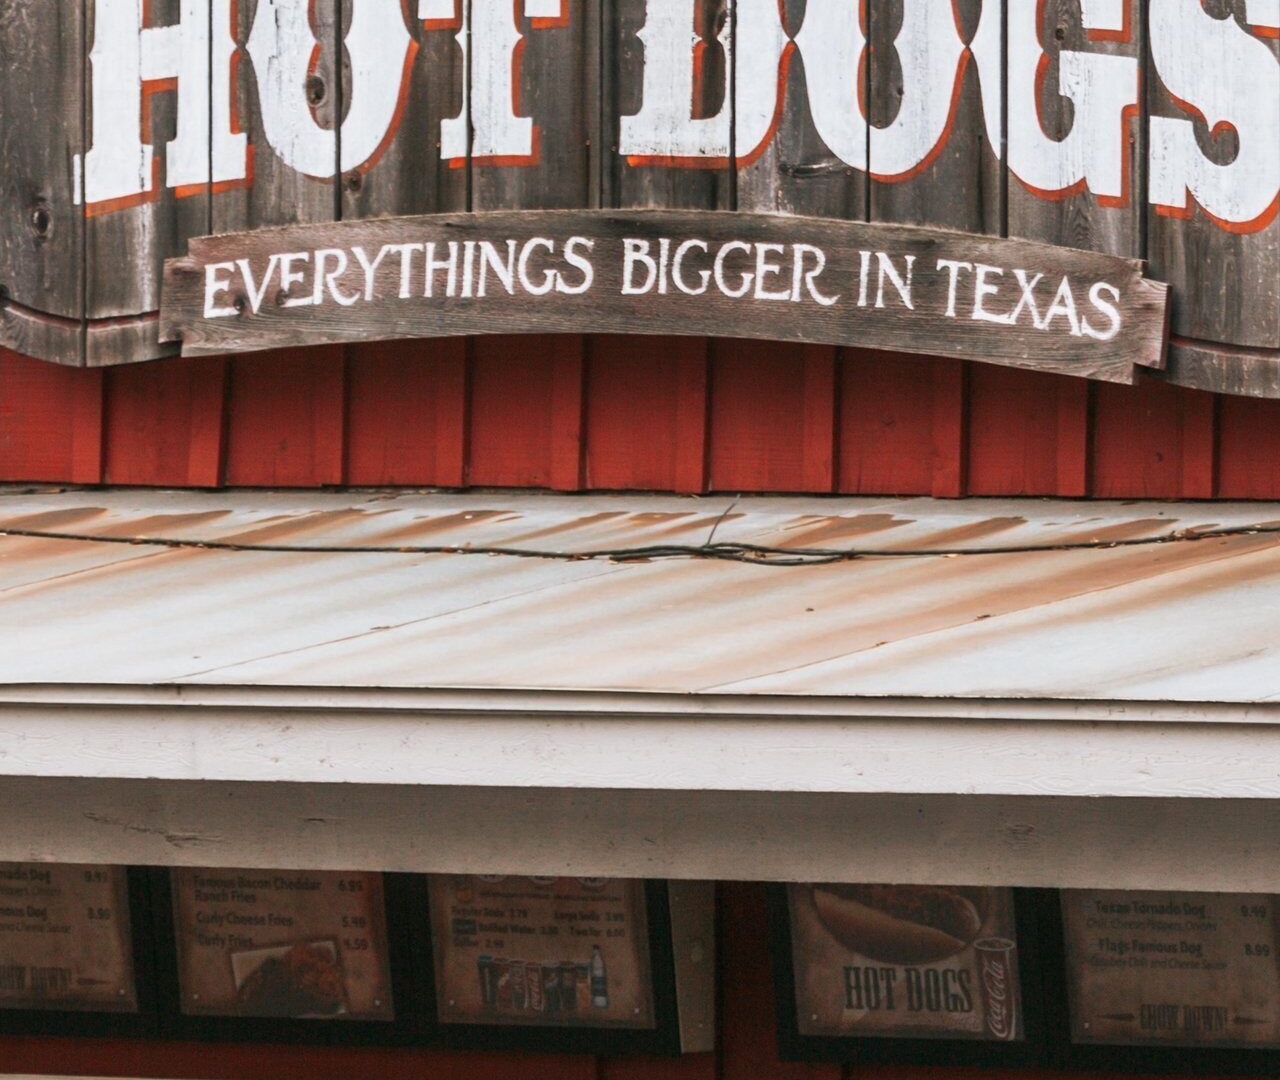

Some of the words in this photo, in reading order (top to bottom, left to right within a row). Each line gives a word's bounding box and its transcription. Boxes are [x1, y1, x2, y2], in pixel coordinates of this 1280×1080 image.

[202, 236, 596, 320] EVERYTHINGS
[620, 237, 839, 306] BIGGER
[857, 248, 916, 311] IN
[936, 257, 1121, 342] TEXAS
[1183, 902, 1205, 919] Dog
[1180, 941, 1203, 957] Dog
[843, 966, 897, 1011] HOT
[904, 967, 973, 1013] DOGS
